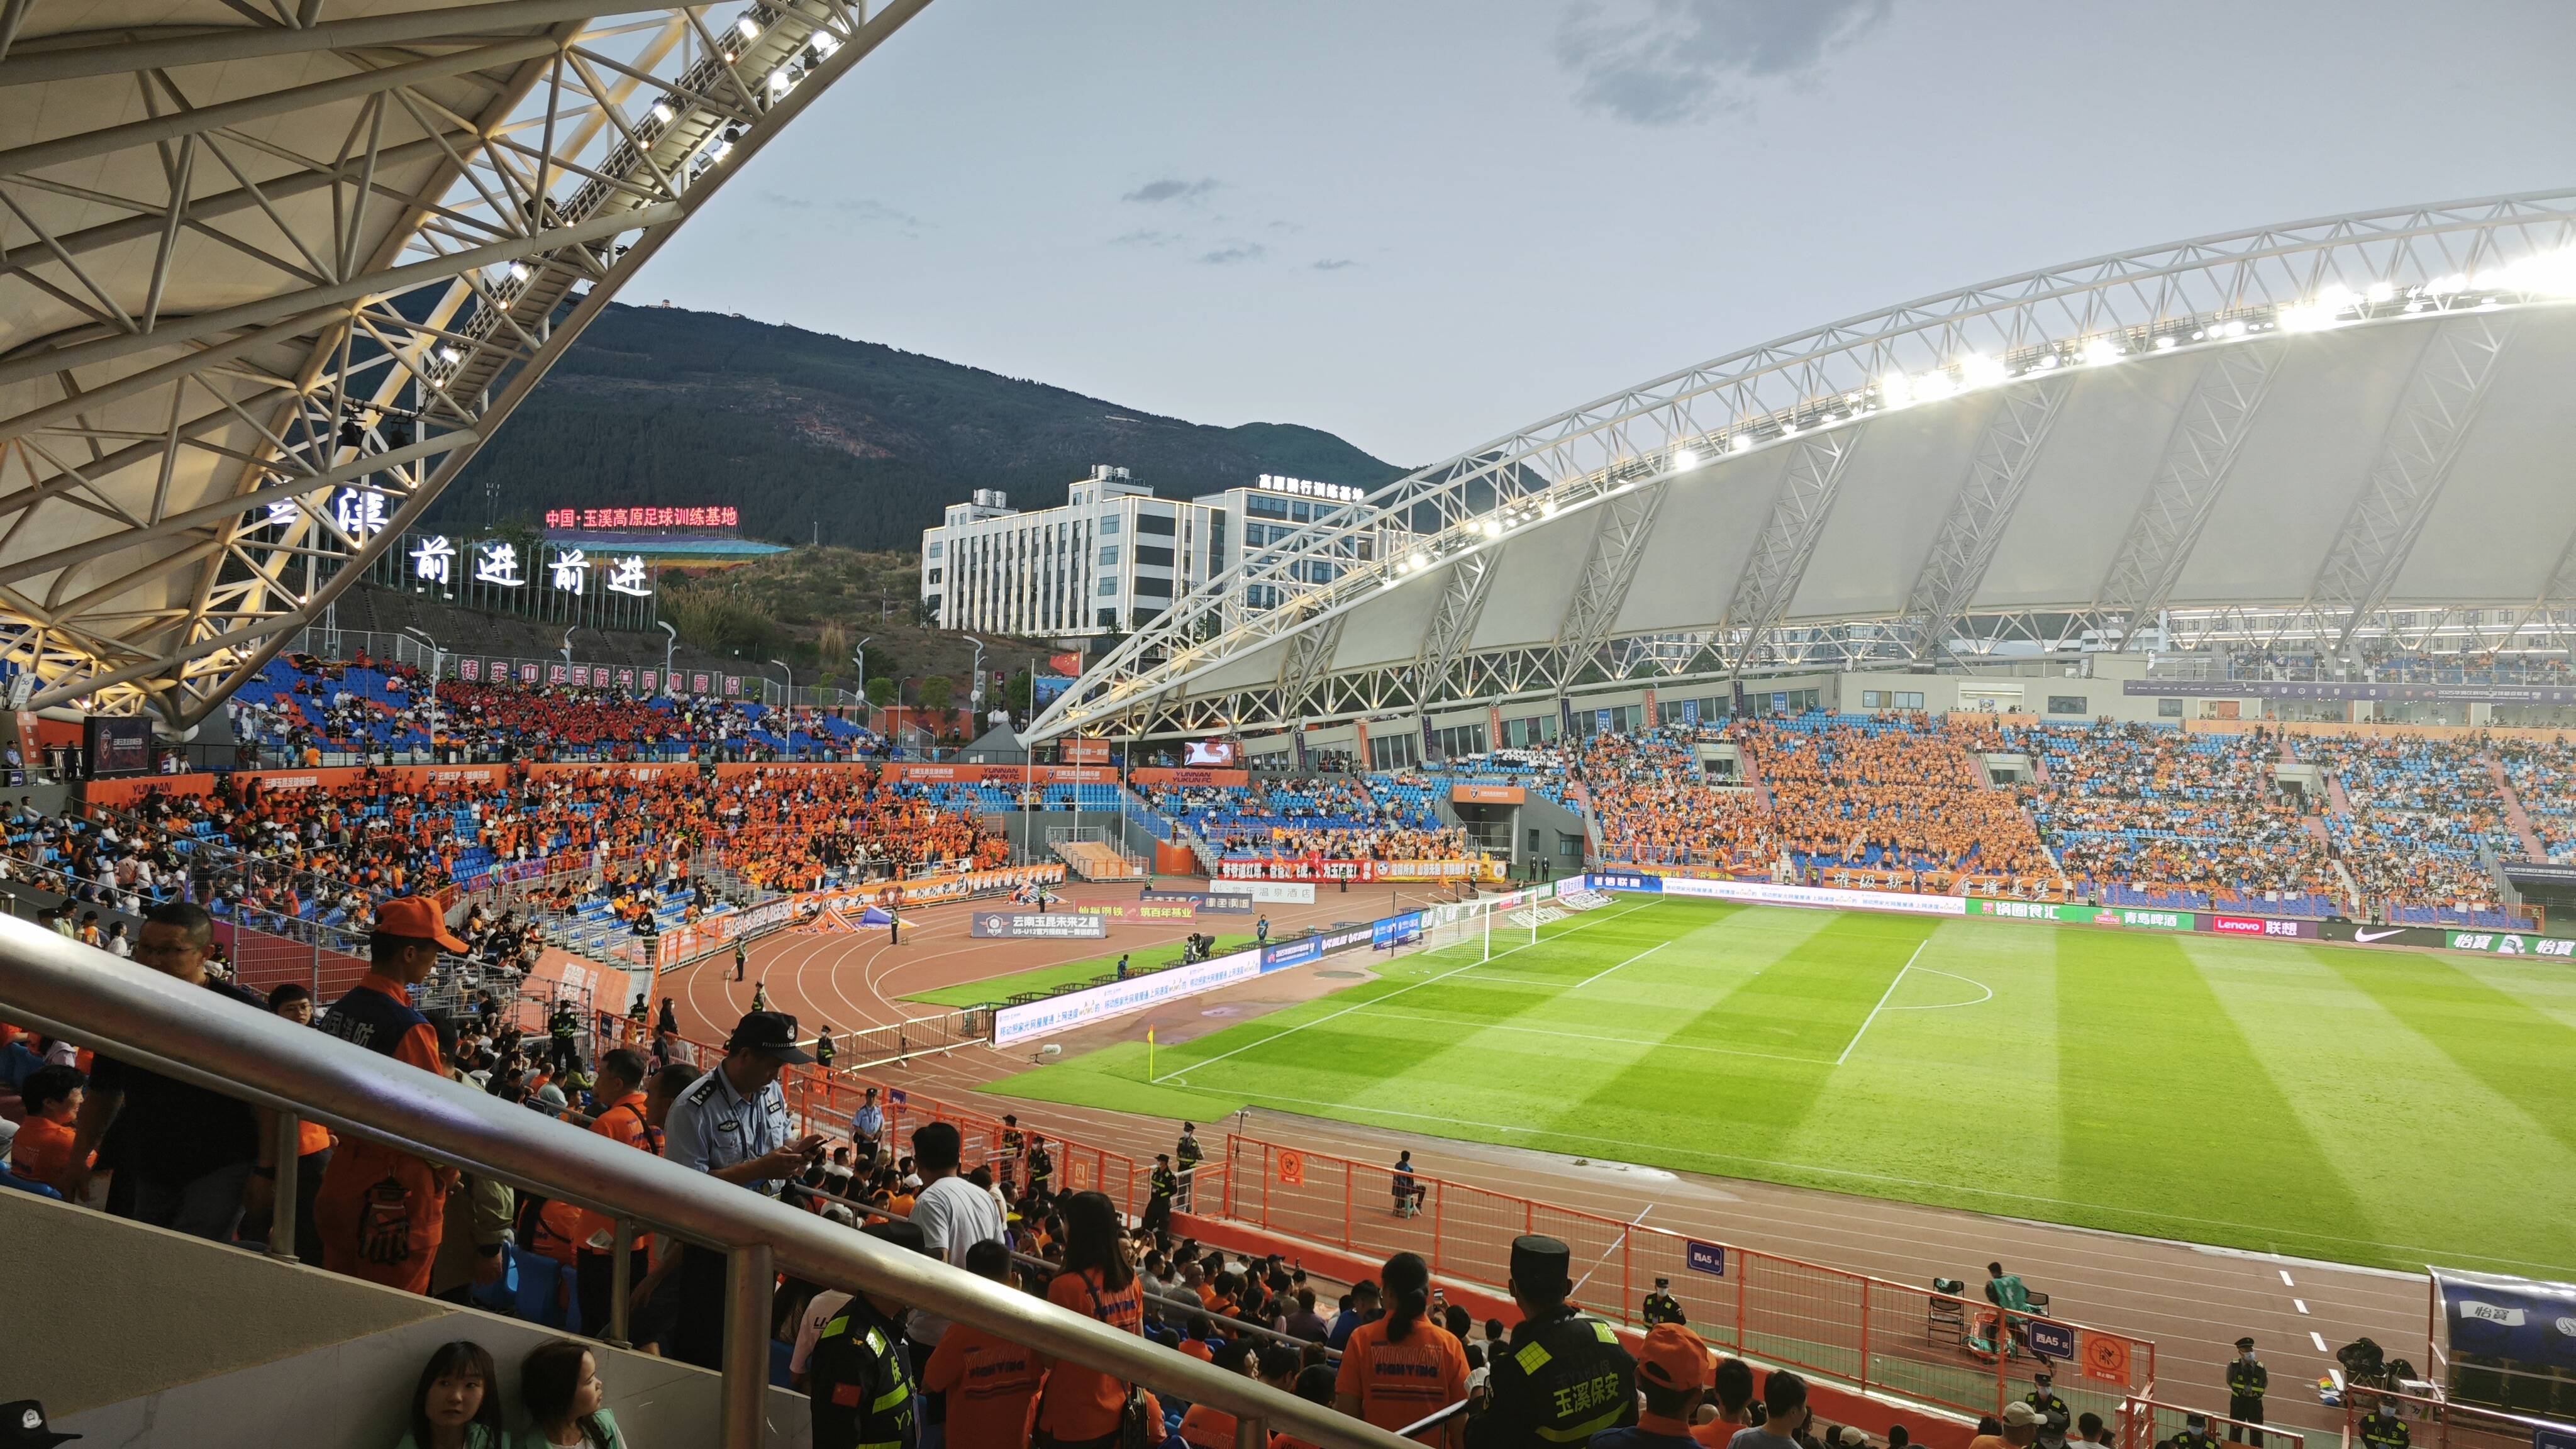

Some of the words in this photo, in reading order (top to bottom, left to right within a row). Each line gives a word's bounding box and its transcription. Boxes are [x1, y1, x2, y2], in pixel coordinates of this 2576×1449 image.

[546, 506, 737, 528] 中国·玉溪高原足球训练基地
[461, 659, 740, 695] 铸牢中华民族共同体意识
[1996, 901, 2060, 919] 锅圈食汇
[1013, 916, 1099, 928] 云南玉昆未来之星
[2217, 919, 2259, 931] Lenovo
[2265, 921, 2297, 936] 联想
[2036, 1332, 2059, 1346] 西A5
[1553, 1372, 1619, 1418] 玉溪保安
